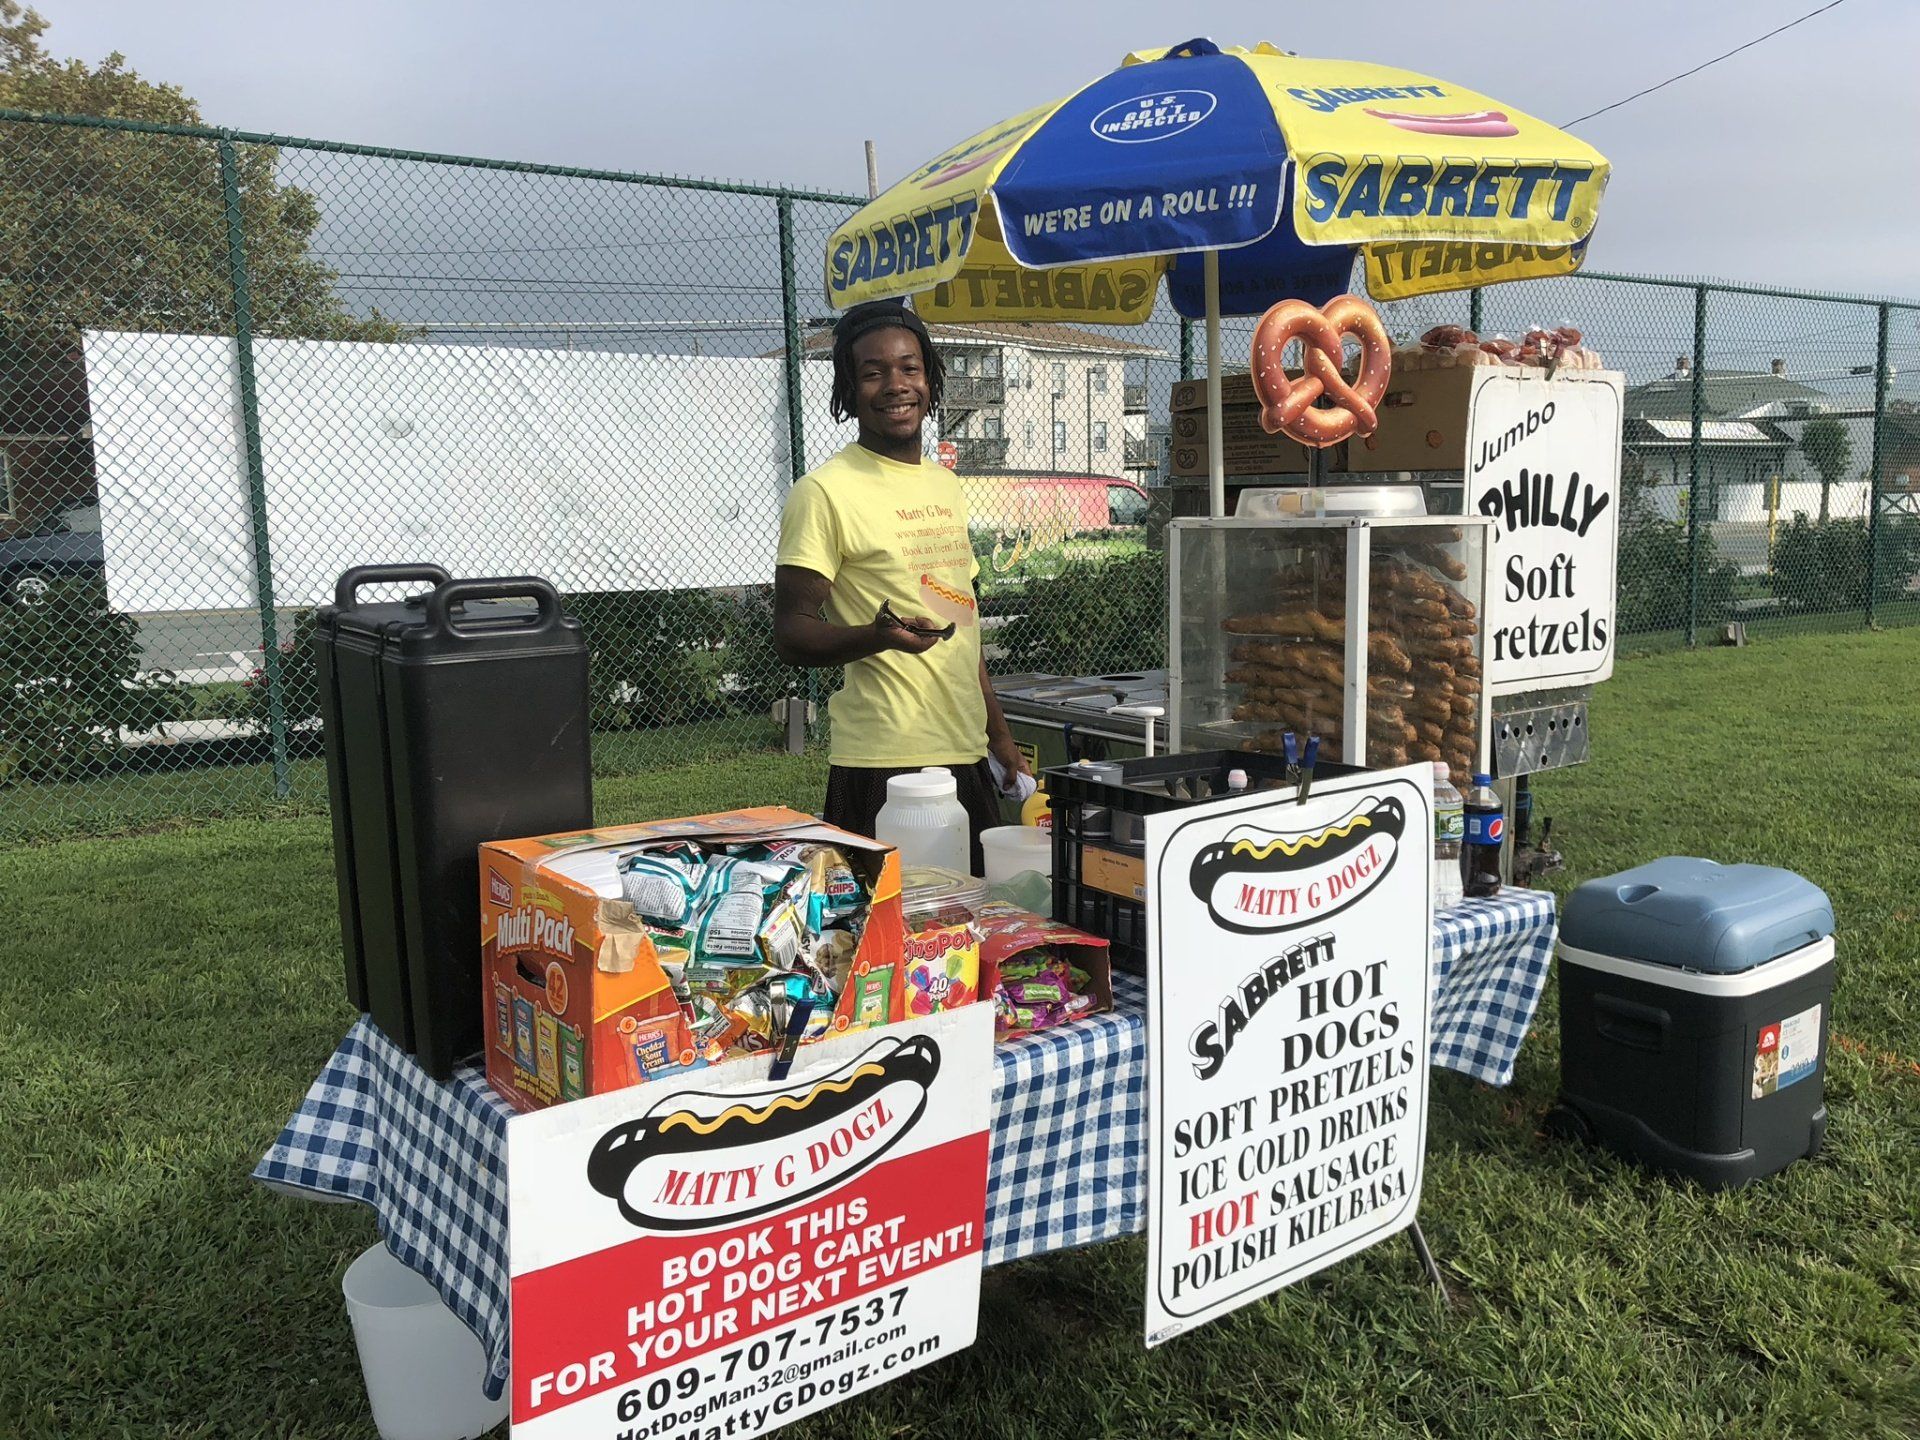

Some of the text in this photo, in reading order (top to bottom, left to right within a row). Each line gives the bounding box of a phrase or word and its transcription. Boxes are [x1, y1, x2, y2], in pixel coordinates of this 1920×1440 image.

[1101, 111, 1201, 134] INSPECTED
[1280, 84, 1446, 113] SABRETT
[1024, 204, 1092, 237] WE'RE
[1100, 199, 1132, 225] ON
[1139, 196, 1153, 219] A
[1162, 188, 1219, 217] ROLL
[1303, 153, 1594, 223] SABRETT
[831, 189, 979, 291] SABRETT
[1474, 401, 1556, 474] Jumbo
[896, 507, 925, 521] Matty
[926, 504, 935, 517] G
[1478, 468, 1609, 543] PHILLY
[902, 545, 923, 556] Book
[1505, 552, 1577, 603] Soft
[1493, 608, 1607, 662] retzels
[1234, 844, 1383, 916] MATTY G DOGZ
[497, 904, 575, 956] Multi Pack
[930, 977, 948, 994] 40
[1189, 931, 1337, 1081] SABRETT
[1297, 960, 1389, 1022] HOT
[636, 1040, 666, 1056] Cheddar
[638, 1030, 662, 1044] HERR'S
[642, 1056, 665, 1071] Cream
[645, 1049, 662, 1062] Sour
[683, 1052, 692, 1061] 20
[1281, 1001, 1400, 1075] DOGS
[1173, 1040, 1414, 1158] SOFT PRETZELS
[652, 1098, 895, 1206] MATTY G DOGZ
[1179, 1086, 1408, 1206] ICE COLD DRINKS
[1188, 1133, 1398, 1250] HOT SAUSAGE
[661, 1196, 869, 1290] BOOK THIS
[1171, 1167, 1407, 1300] POLISH KIELBASA
[626, 1216, 906, 1337] HOT DOG CART
[529, 1223, 974, 1409] FOR YOUR NEXT EVENT!
[616, 1324, 907, 1440] HotDogMan32@gmail.com
[617, 1286, 909, 1423] 609-707-7537
